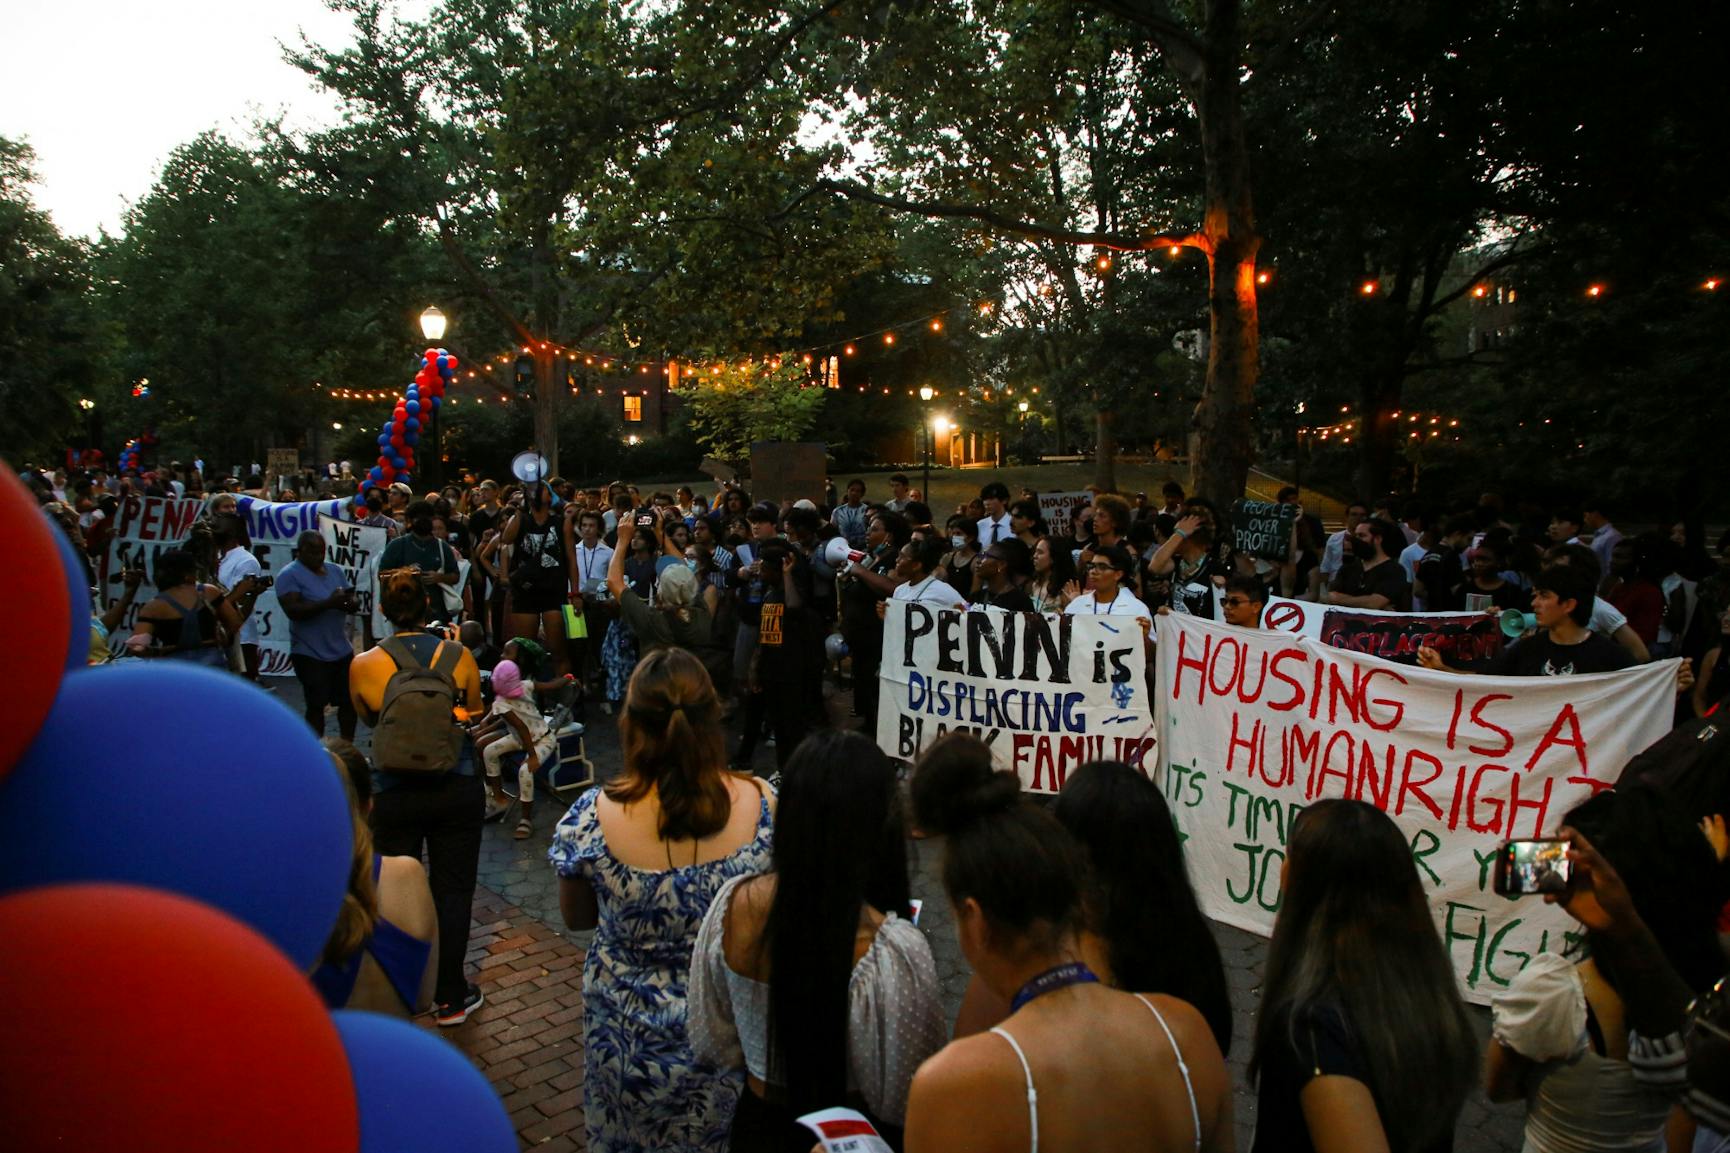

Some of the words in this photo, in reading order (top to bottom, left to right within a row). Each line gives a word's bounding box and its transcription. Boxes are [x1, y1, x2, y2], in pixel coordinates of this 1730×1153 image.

[1041, 495, 1091, 508] HOUSING
[1055, 509, 1064, 517] IS
[1242, 500, 1292, 518] PEOPLE
[333, 523, 361, 549] WE
[1248, 518, 1280, 534] OVER
[903, 602, 1073, 684] PENN
[1092, 640, 1134, 684] is
[908, 670, 1086, 733] DISPLACING
[1173, 631, 1408, 731] HOUSING
[1446, 688, 1514, 757] IS
[1525, 703, 1588, 775] A
[899, 713, 1000, 758] BLK
[1166, 758, 1207, 807] IT'S
